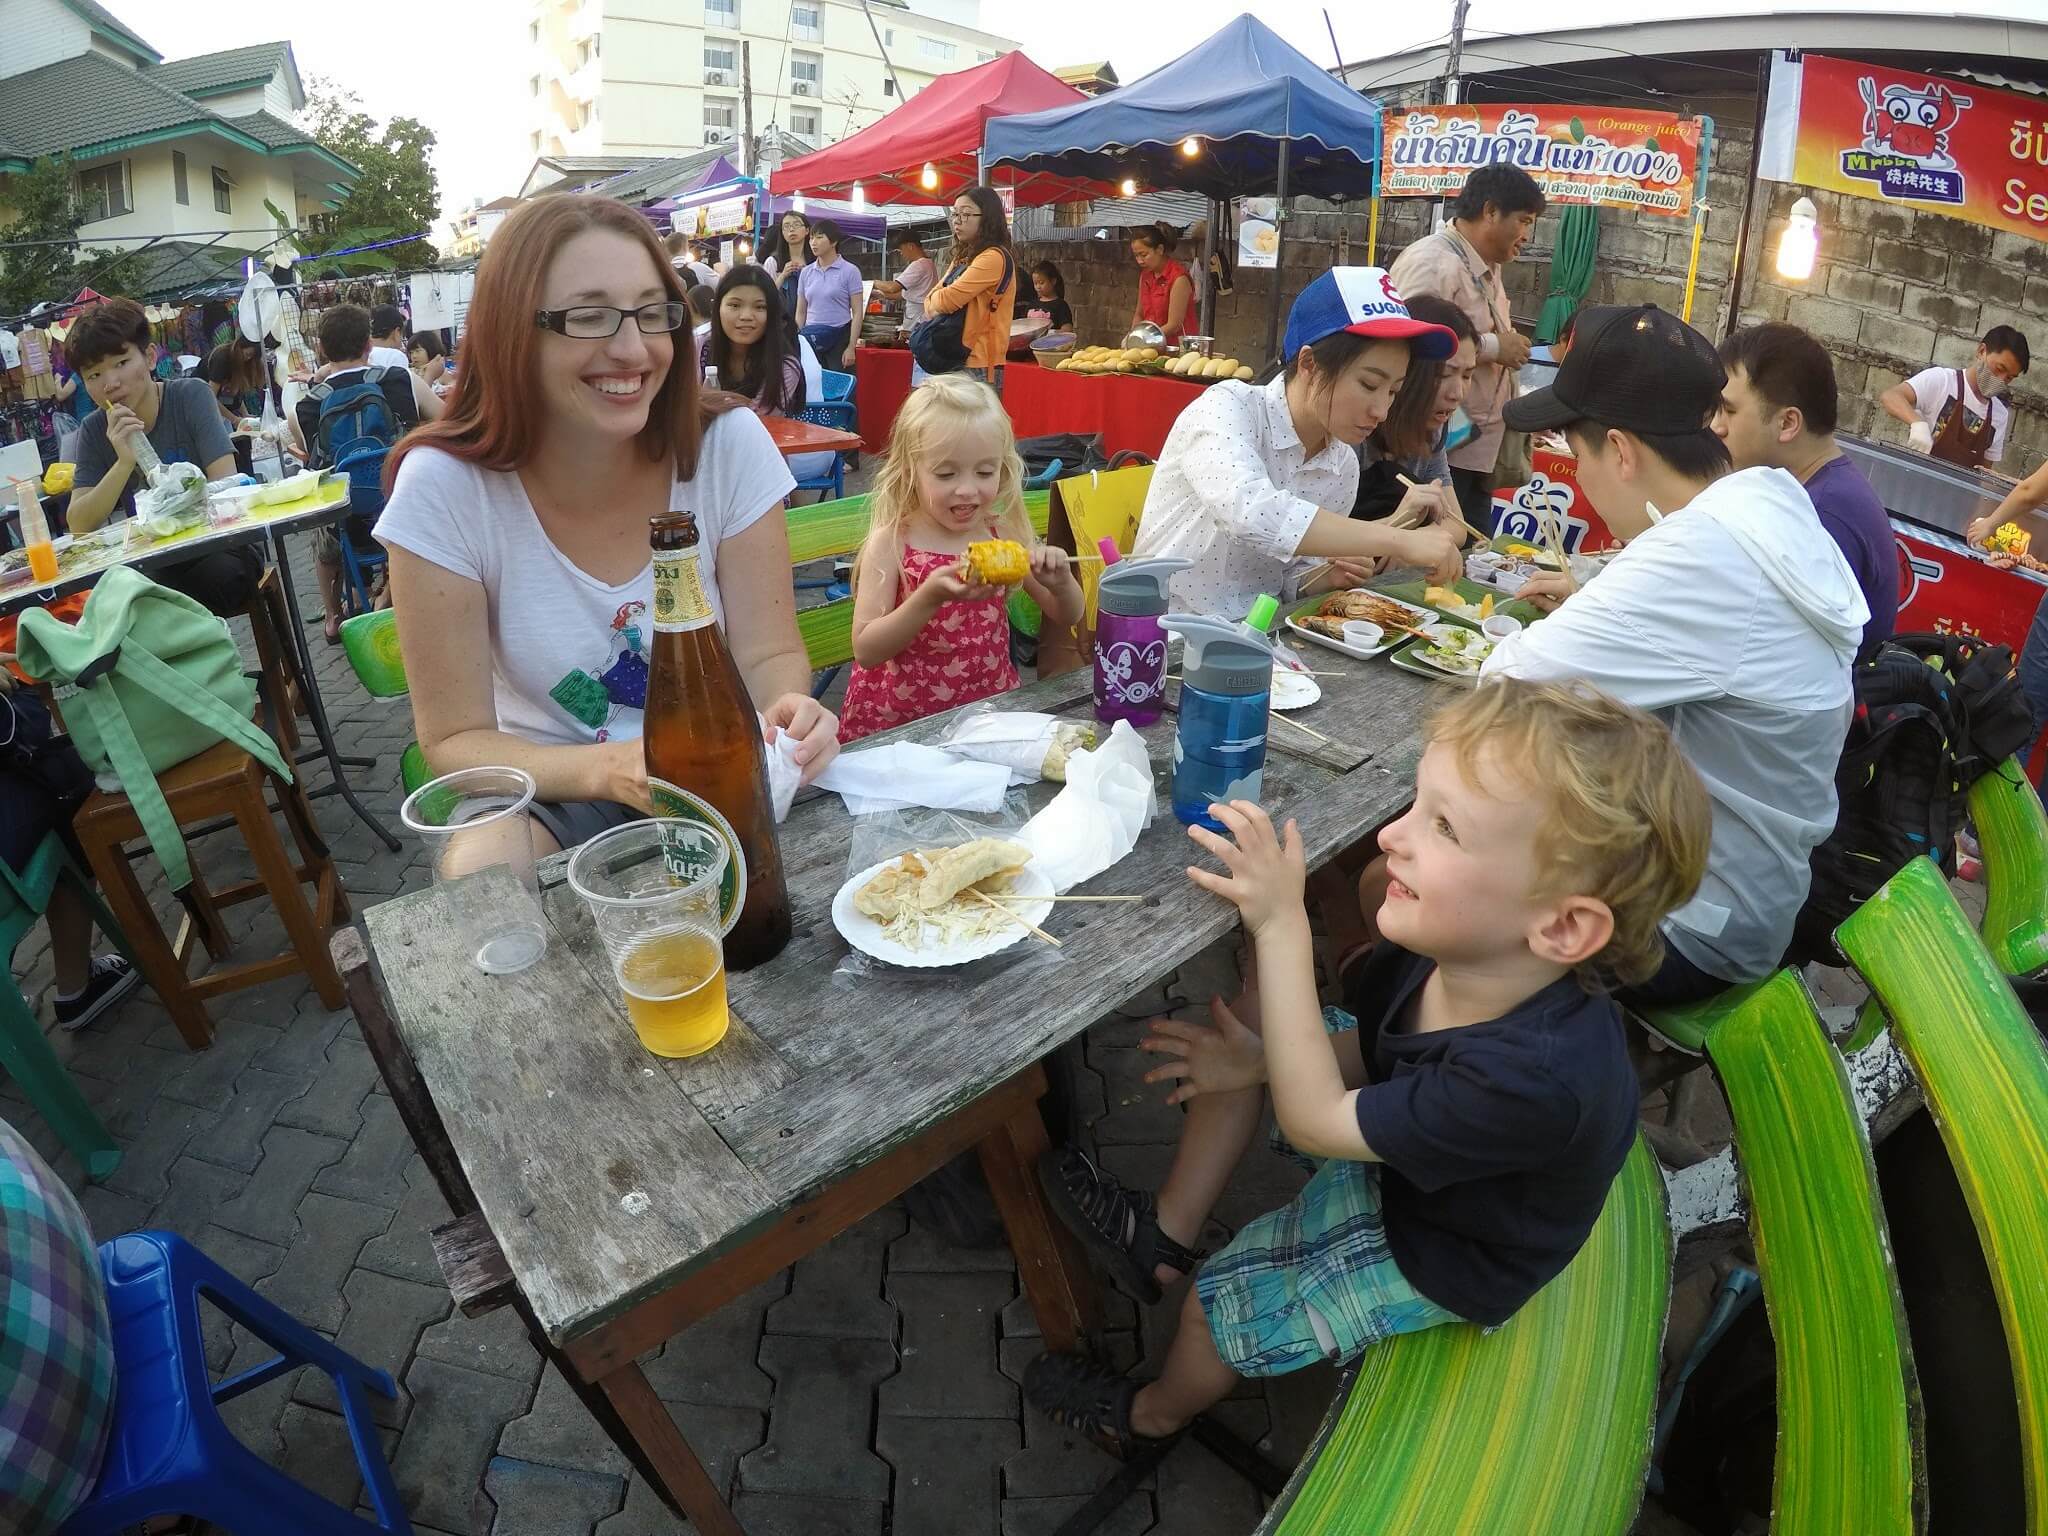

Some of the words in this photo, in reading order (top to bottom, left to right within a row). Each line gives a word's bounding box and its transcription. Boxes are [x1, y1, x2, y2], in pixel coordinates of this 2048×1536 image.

[1598, 117, 1651, 137] (Orange
[1655, 122, 1691, 138] juice)
[1394, 113, 1549, 167] น้ำส้มคั้น
[1551, 139, 1606, 172] แท้
[1600, 149, 1678, 182] 100%
[1886, 168, 1949, 194] 烧烤先生
